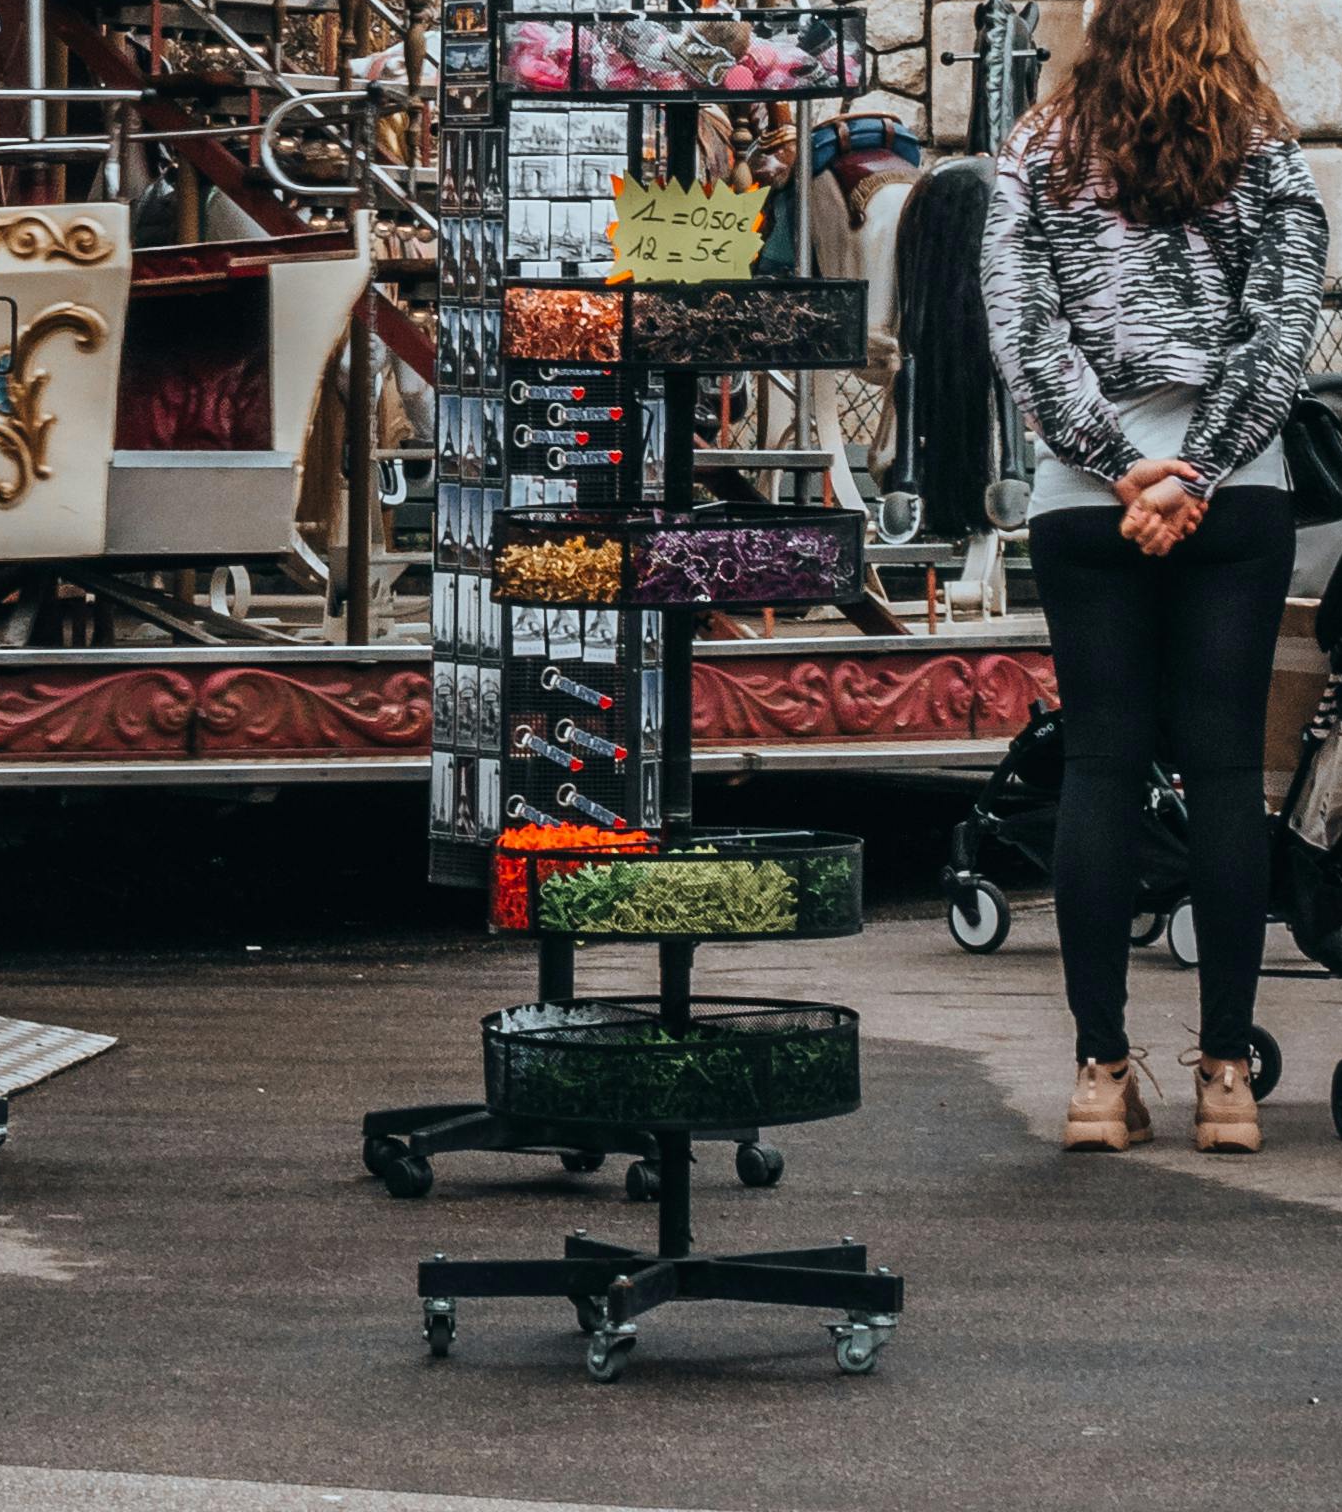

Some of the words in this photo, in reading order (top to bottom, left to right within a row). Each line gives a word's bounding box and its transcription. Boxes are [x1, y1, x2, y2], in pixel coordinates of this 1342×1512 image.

[631, 199, 666, 222] 1
[626, 235, 658, 261] 12
[689, 237, 734, 263] 5€
